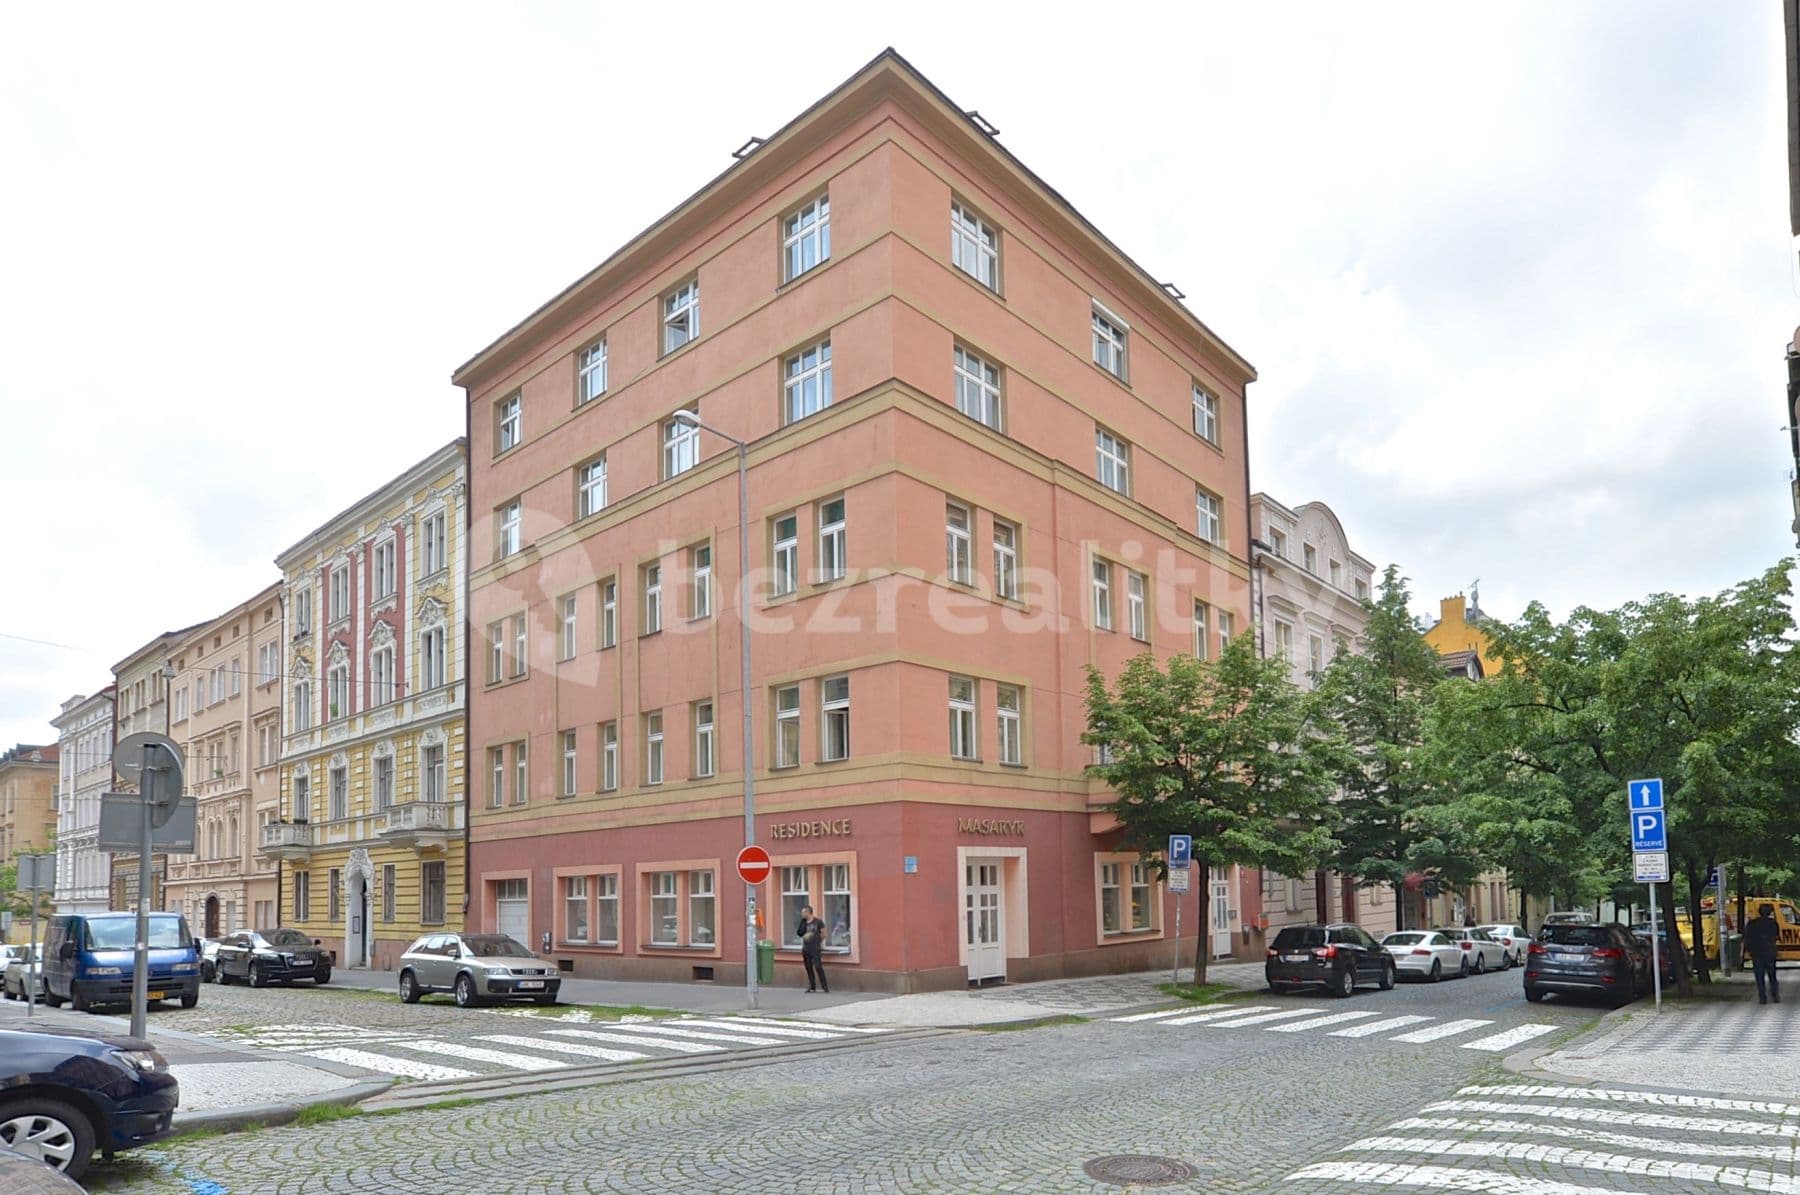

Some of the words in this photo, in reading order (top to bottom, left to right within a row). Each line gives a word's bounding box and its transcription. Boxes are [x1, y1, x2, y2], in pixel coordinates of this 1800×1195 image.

[769, 818, 851, 838] RESIDENCE
[958, 817, 1024, 836] MASARYK
[1638, 815, 1657, 839] P
[1174, 839, 1186, 858] P
